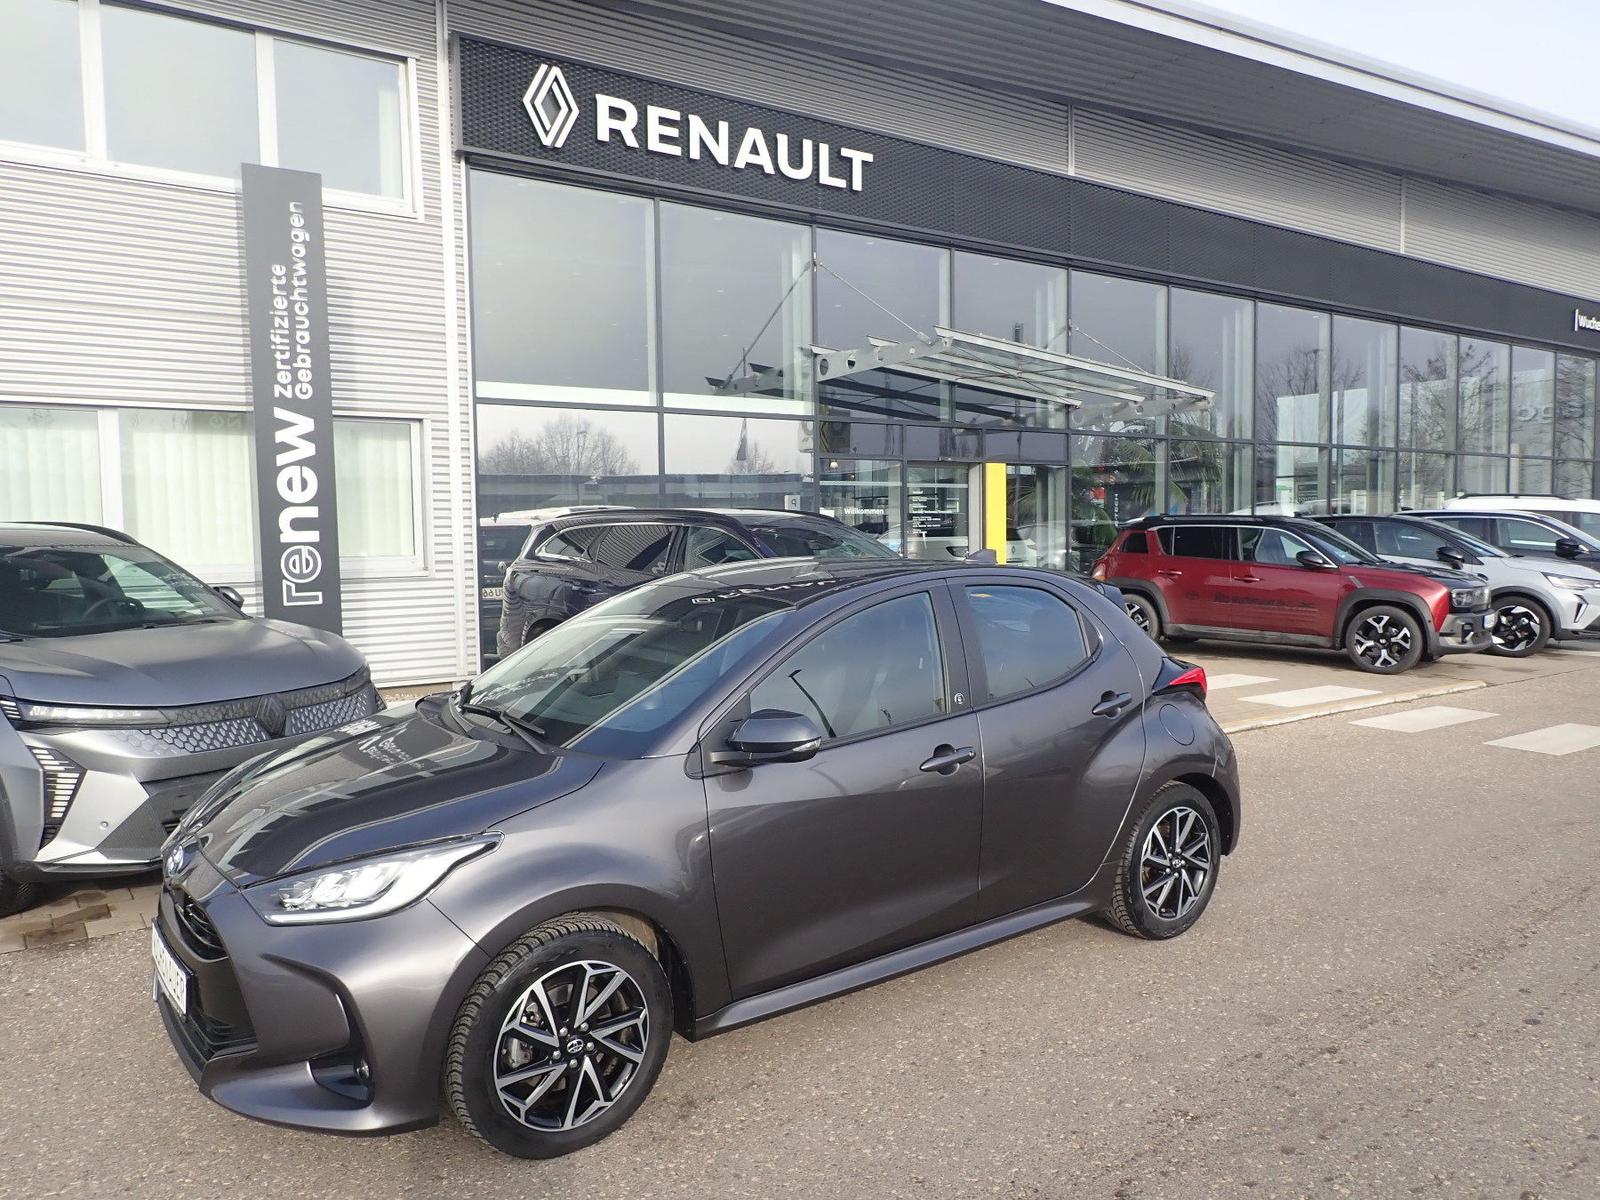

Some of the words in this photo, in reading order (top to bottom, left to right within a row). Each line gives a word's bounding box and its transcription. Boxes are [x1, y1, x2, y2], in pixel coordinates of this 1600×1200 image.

[595, 93, 874, 192] RENAULT
[269, 264, 293, 399] Zertifizierte
[289, 201, 314, 400] Gebrauchtwagen
[273, 406, 323, 607] renew
[844, 507, 884, 515] Willkommen
